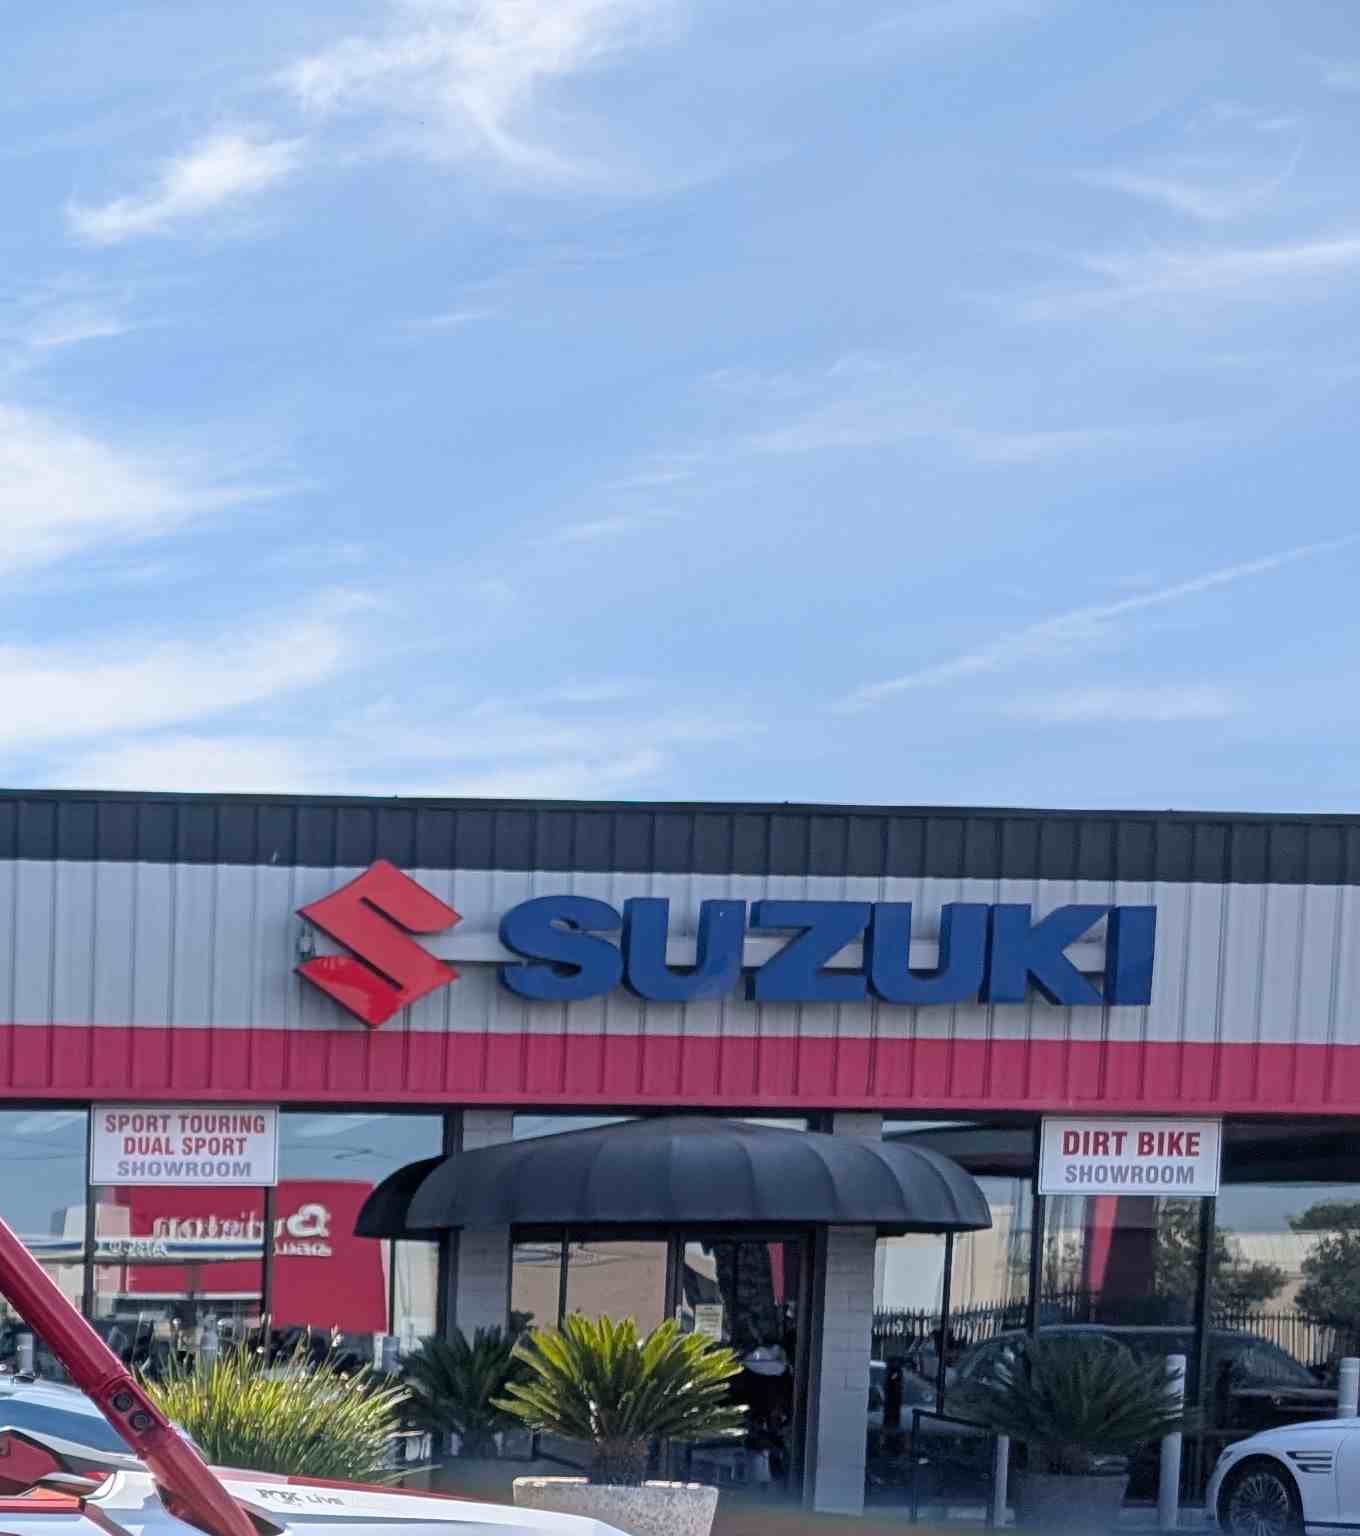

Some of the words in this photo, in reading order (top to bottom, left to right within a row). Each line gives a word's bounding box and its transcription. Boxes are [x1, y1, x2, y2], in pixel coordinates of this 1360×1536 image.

[498, 894, 1157, 1007] SUZUKI
[105, 1114, 173, 1134] SPORT
[180, 1114, 265, 1134] TOURING
[123, 1137, 175, 1156] DUAL
[181, 1137, 247, 1156] SPORT
[1062, 1131, 1128, 1157] DIRT
[1136, 1131, 1201, 1157] BIKE
[117, 1160, 252, 1178] SHOWROOM
[1064, 1164, 1195, 1185] SHOWROOM
